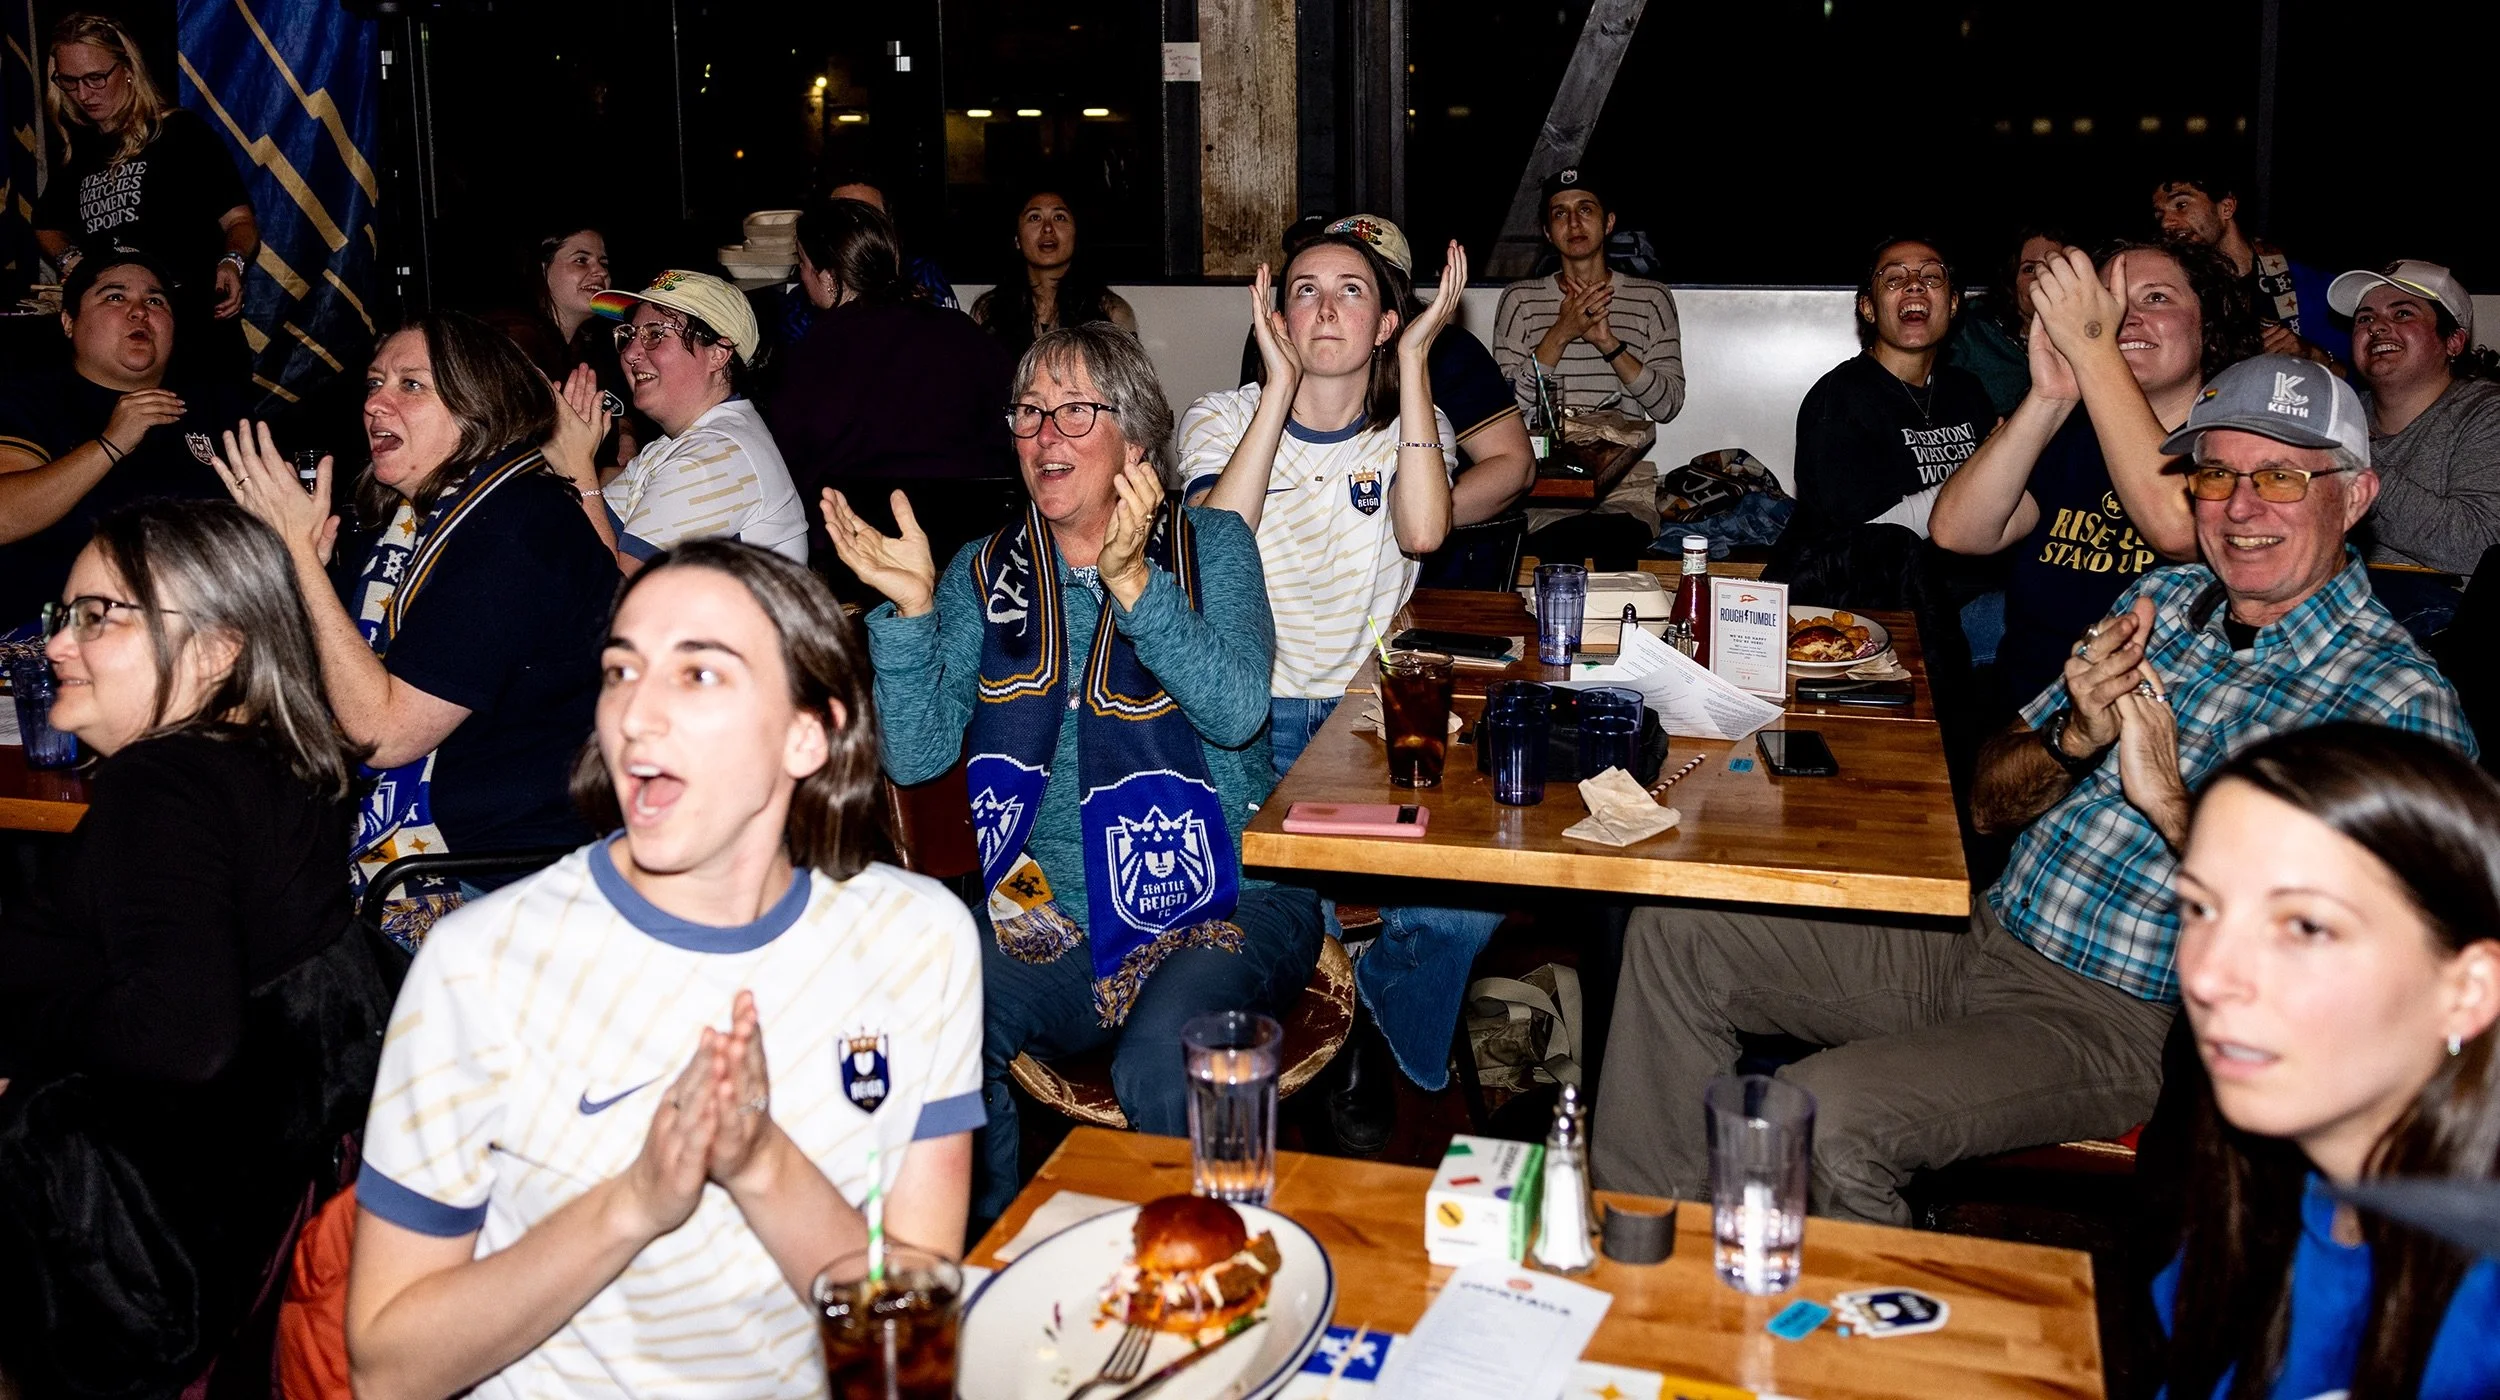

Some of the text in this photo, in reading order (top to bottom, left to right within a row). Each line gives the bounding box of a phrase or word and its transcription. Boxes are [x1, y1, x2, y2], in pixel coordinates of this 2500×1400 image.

[80, 190, 141, 220] WOMEN'S
[86, 207, 139, 234] SPORTS.
[2268, 402, 2309, 418] KEITH
[2049, 508, 2117, 551] RISE
[2039, 542, 2155, 574] STAND UP
[1720, 607, 1777, 627] ROUGH TUMBLE
[1142, 880, 1185, 896] SEATTLE
[1140, 892, 1187, 914] REIGN
[1158, 908, 1171, 919] FC
